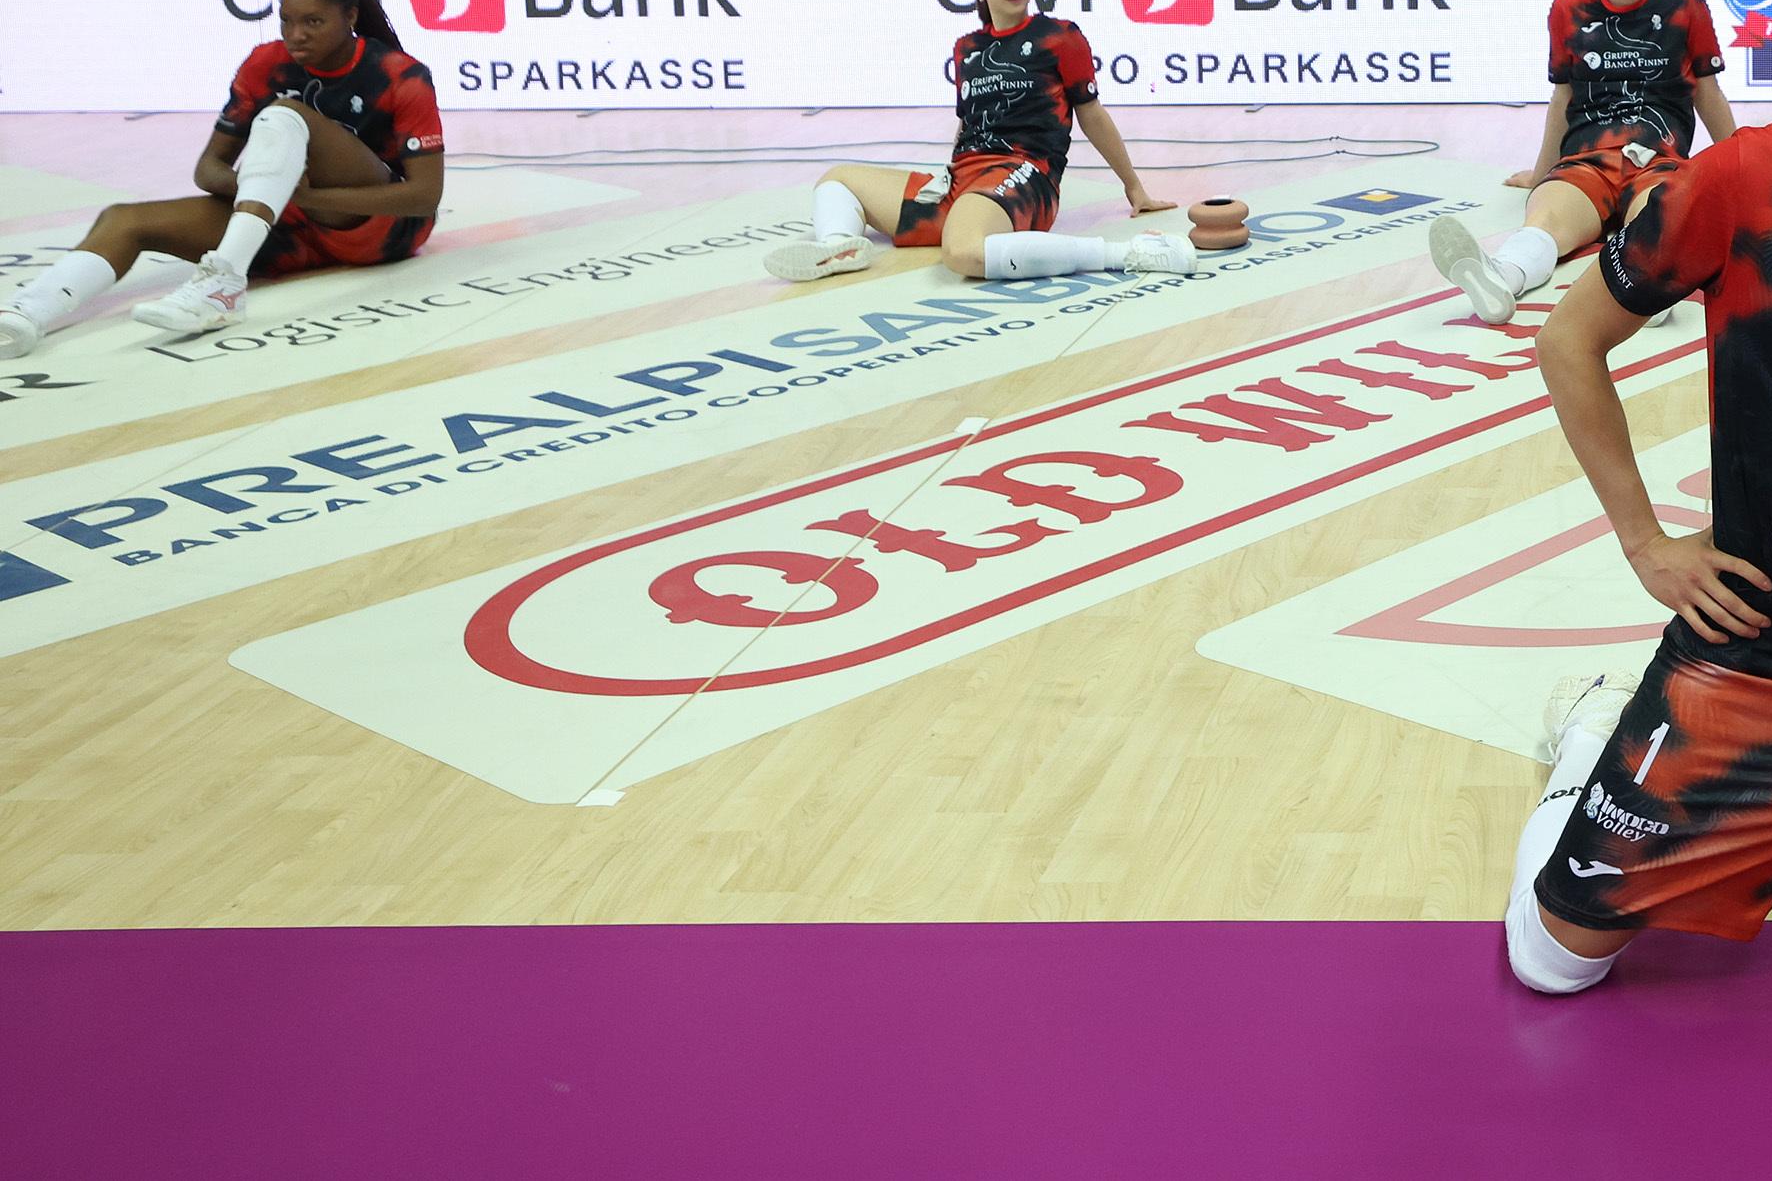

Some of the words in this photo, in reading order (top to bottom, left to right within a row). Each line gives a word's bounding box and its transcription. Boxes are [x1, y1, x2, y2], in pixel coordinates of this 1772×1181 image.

[1164, 52, 1453, 84] SPARKASSE
[1603, 51, 1640, 59] GRUPPO
[1603, 59, 1636, 69] BANCA
[1637, 58, 1669, 67] FININT
[458, 59, 747, 91] SPARKASSE
[970, 84, 999, 97] BANCA
[999, 79, 1034, 90] FININT
[971, 73, 1003, 86] GRUPPO
[459, 217, 815, 296] Engineerin
[112, 497, 371, 567] BANCA
[374, 471, 447, 495] DI
[455, 407, 699, 475] CREDITO
[702, 317, 1037, 409] COOPERATIVO
[1060, 271, 1216, 315] GRUPPO
[1218, 240, 1327, 271] CASSA
[1331, 200, 1486, 242] CENTRALE
[24, 347, 797, 550] PREALPI
[647, 449, 1185, 629] OLD
[1633, 721, 1671, 785] 1
[1596, 812, 1646, 842] Volley
